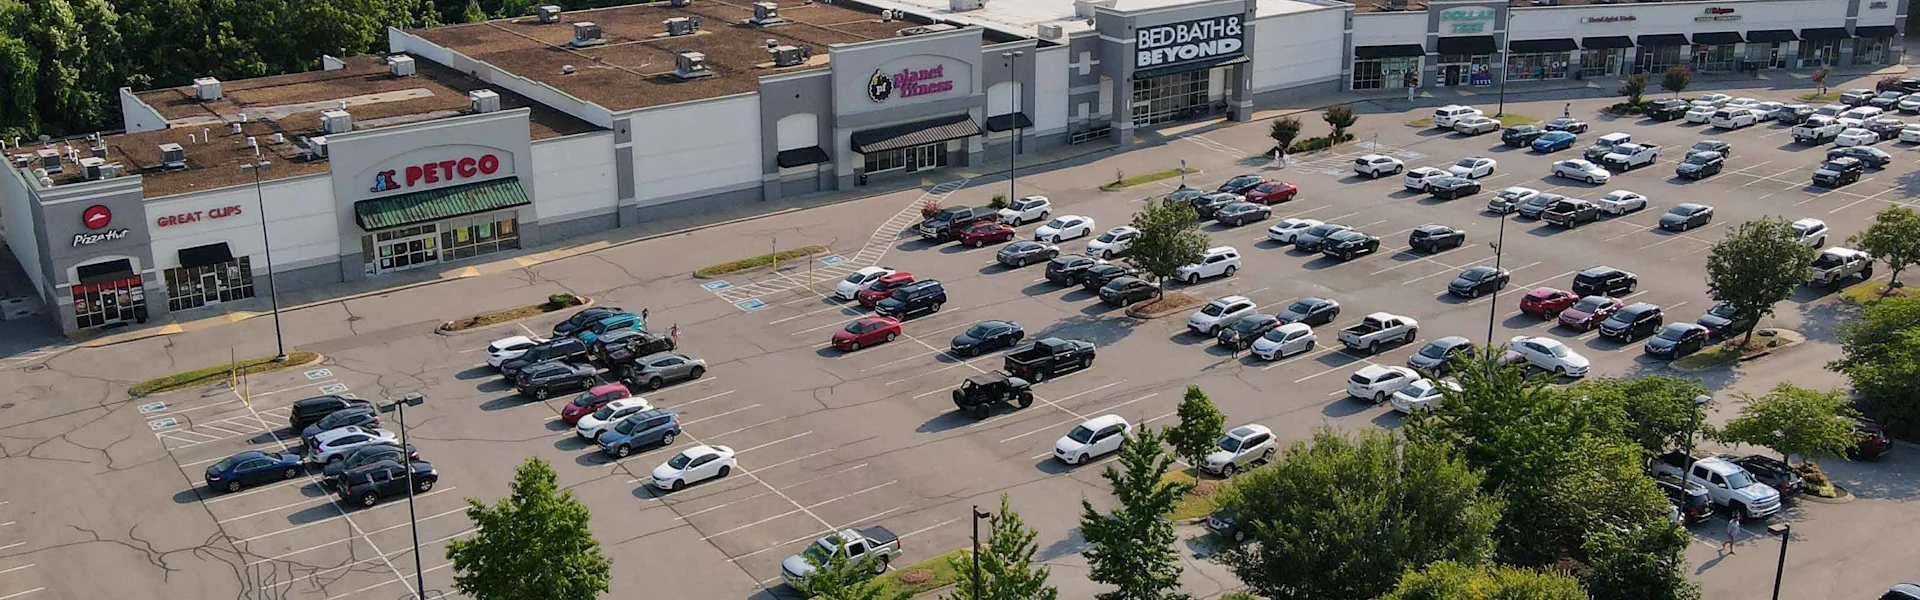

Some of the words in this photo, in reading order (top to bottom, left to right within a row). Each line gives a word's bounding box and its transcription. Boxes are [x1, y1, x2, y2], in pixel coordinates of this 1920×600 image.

[1138, 27, 1176, 49] BED
[1177, 19, 1225, 43] BATH
[1226, 17, 1242, 36] &
[1137, 38, 1242, 67] BEYOND
[893, 64, 944, 89] planet
[901, 80, 953, 98] fitness
[405, 154, 499, 187] PETCO
[157, 211, 203, 227] GREAT
[208, 205, 242, 219] CLIPS
[73, 231, 106, 247] Pizza
[105, 229, 130, 242] Hut
